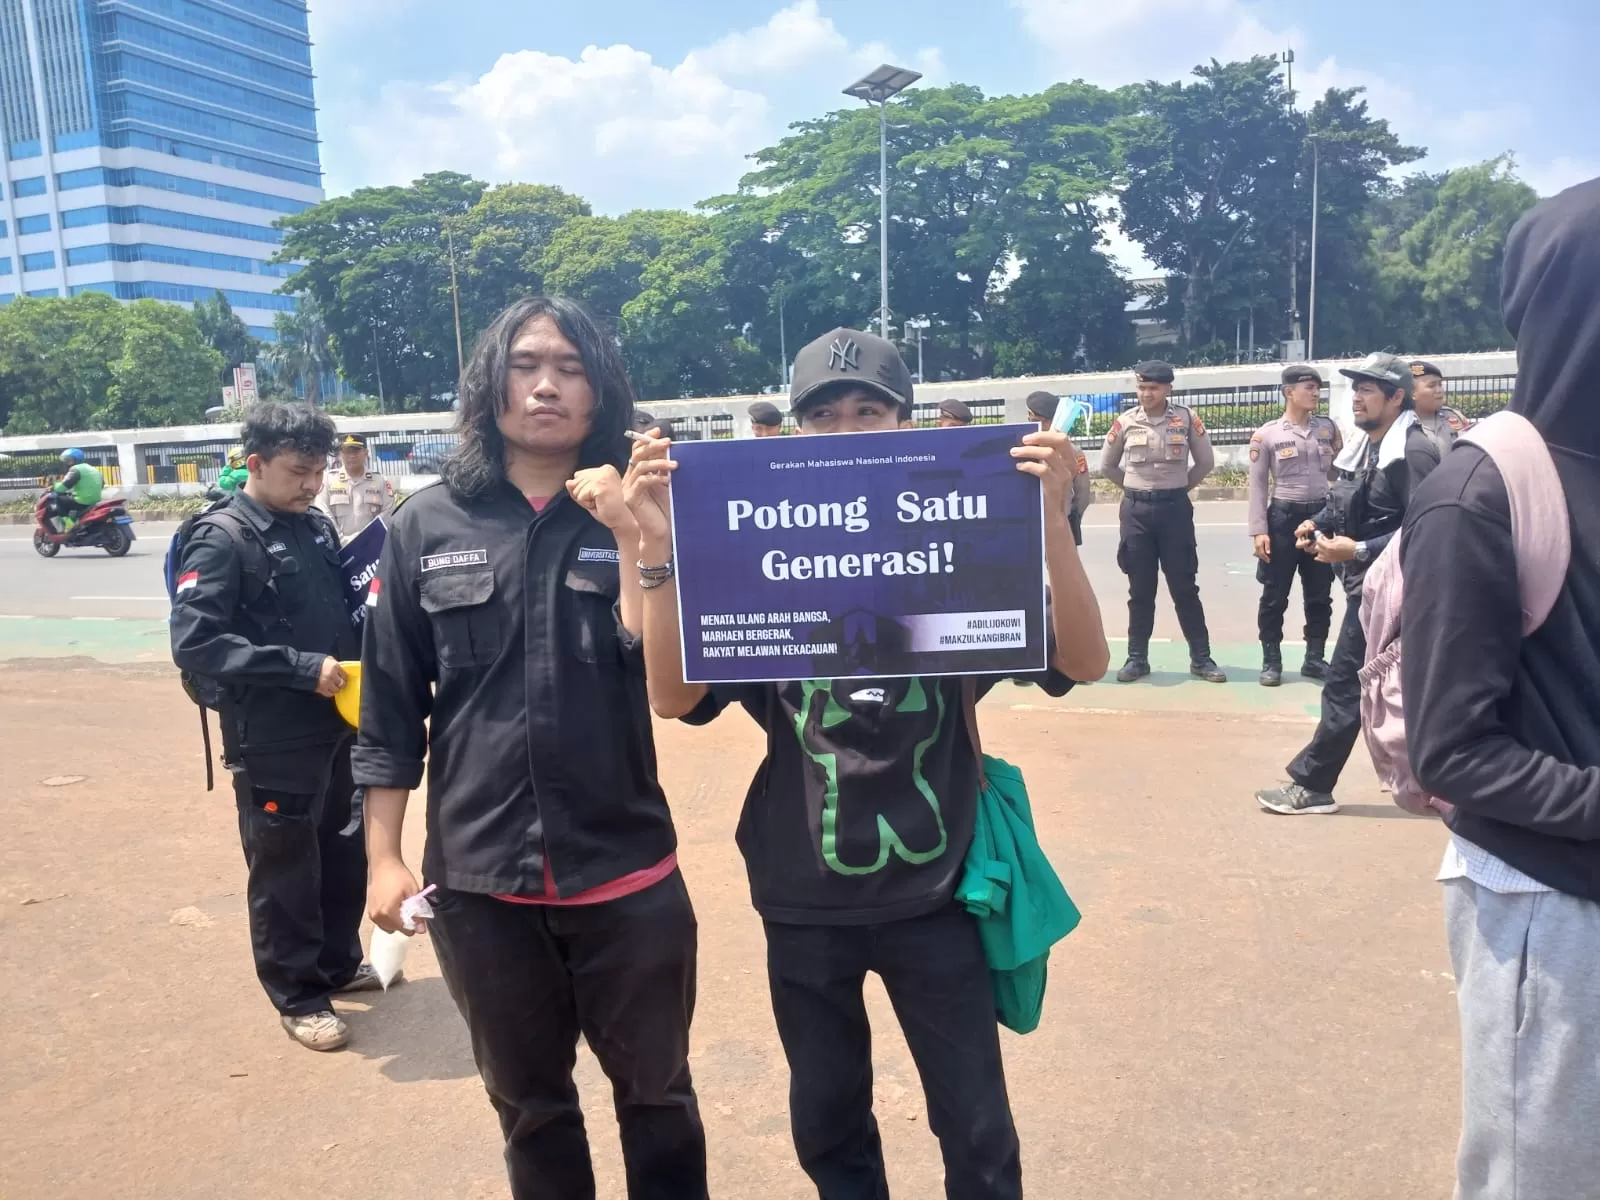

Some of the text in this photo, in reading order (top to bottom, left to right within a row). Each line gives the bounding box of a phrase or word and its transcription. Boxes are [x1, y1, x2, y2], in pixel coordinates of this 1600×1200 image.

[770, 453, 936, 470] Gerakan Mahasiswa Nasional Indonesia
[727, 490, 988, 533] Potong Satu
[452, 553, 480, 564] DAFFA
[761, 541, 955, 581] Generasi!
[700, 611, 831, 626] MENATA ULANG ARAH BANGSA,
[967, 617, 1021, 629] #ADILIJOKOWI
[701, 628, 795, 642] MARHAEN BERGERAK,
[939, 632, 1021, 645] #MAKZULKANGIBRAN
[702, 643, 838, 658] RAKYAT MELAWAN KEKACAUAN!
